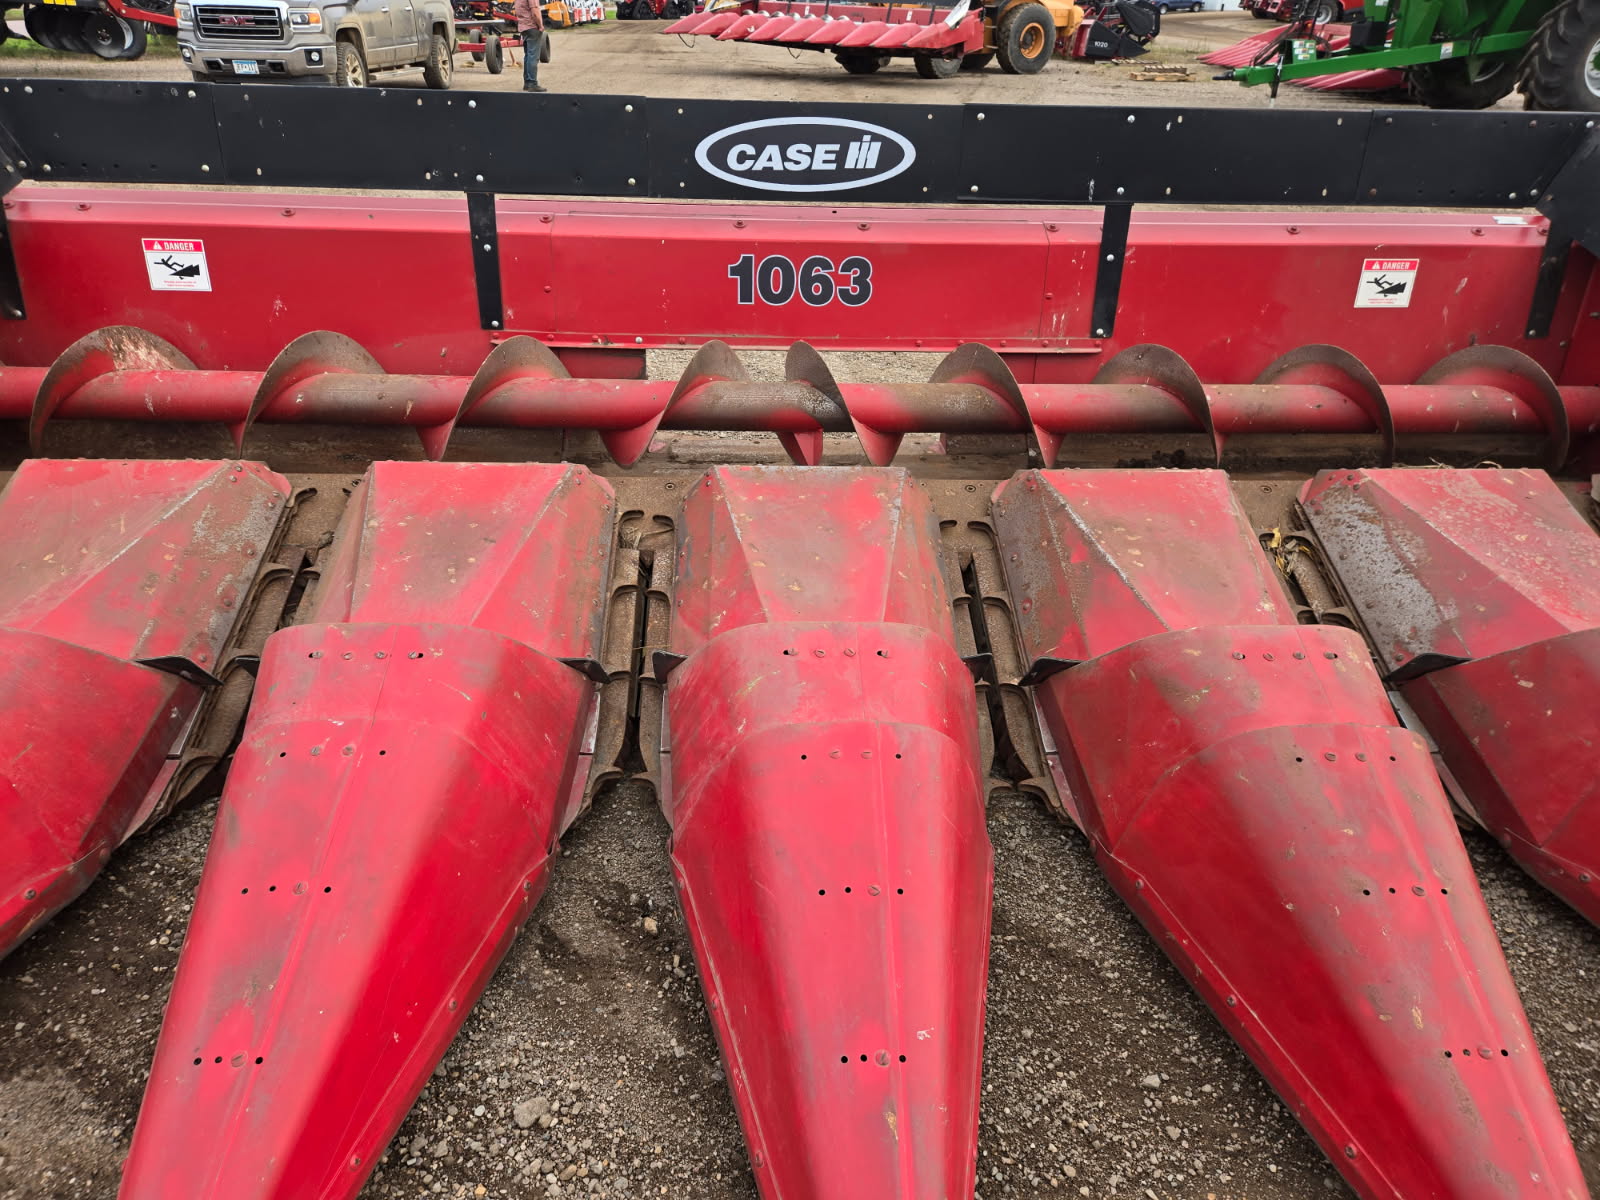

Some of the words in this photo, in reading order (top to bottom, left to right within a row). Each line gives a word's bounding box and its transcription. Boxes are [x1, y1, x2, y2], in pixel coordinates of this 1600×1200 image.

[219, 15, 255, 25] GMC
[726, 143, 841, 171] CASE
[163, 242, 194, 251] DANGER
[1381, 262, 1410, 270] DANGER
[727, 253, 873, 307] 1063
